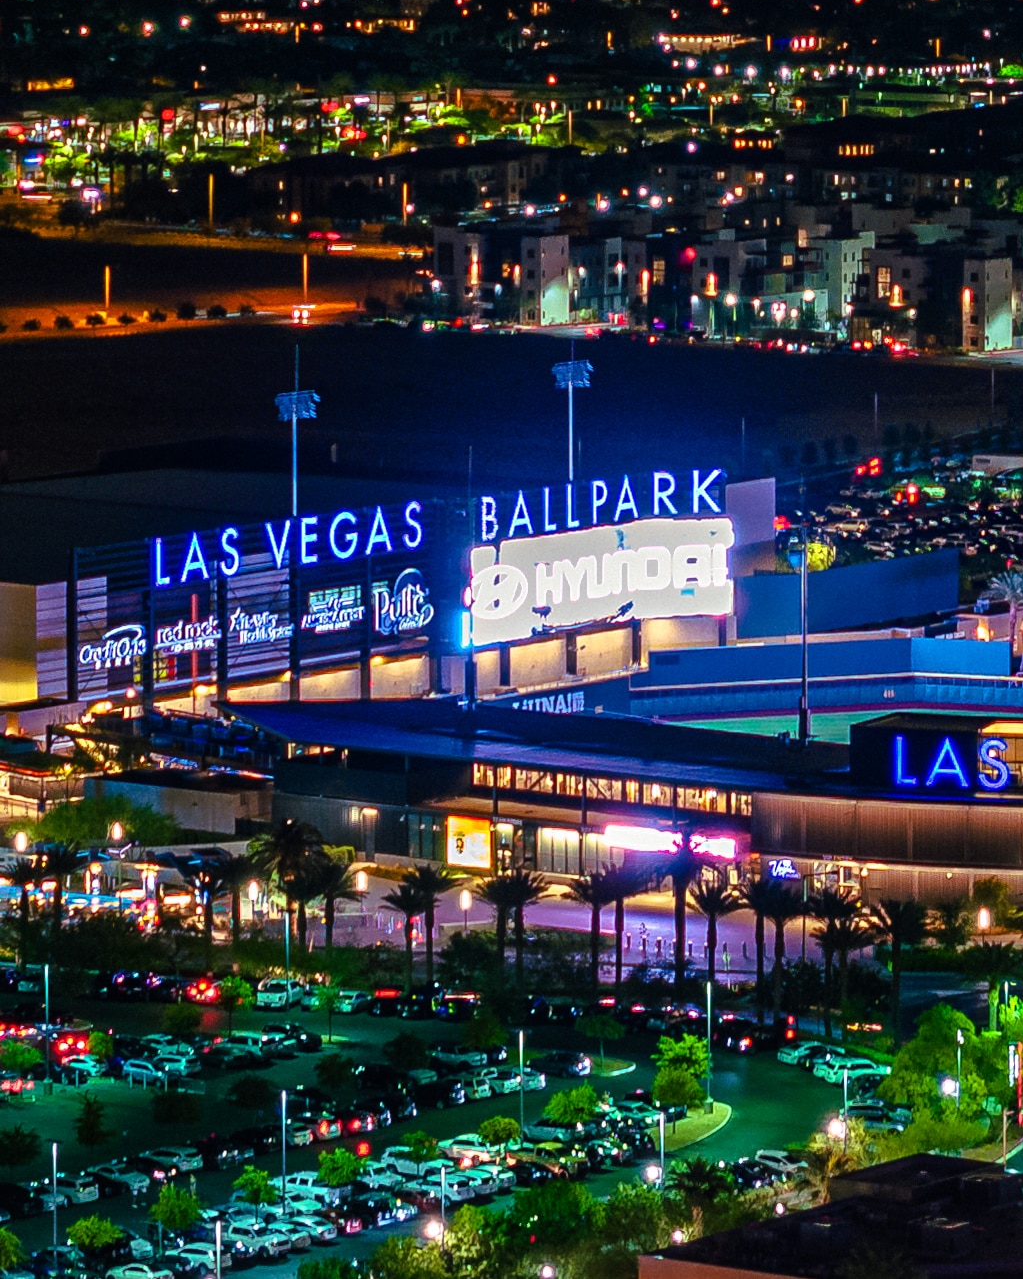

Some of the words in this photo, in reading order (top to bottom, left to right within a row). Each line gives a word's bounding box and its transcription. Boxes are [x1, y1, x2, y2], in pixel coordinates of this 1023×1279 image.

[155, 526, 240, 587] LAS
[265, 501, 424, 569] VEGAS
[480, 468, 723, 542] BALLPARK
[535, 543, 729, 607] HYUNDAI
[155, 619, 184, 644] red
[894, 734, 1010, 790] LAS
